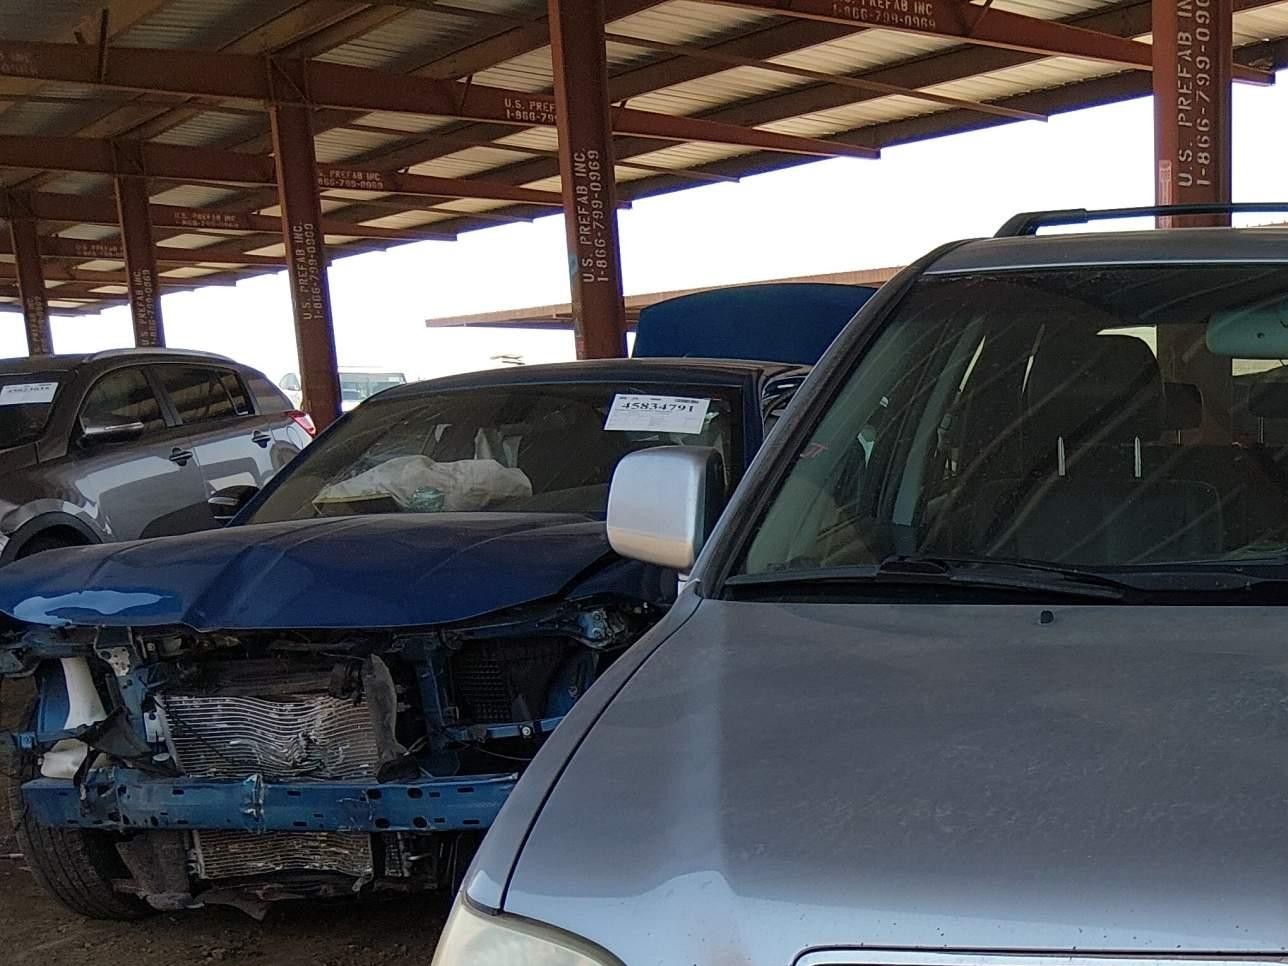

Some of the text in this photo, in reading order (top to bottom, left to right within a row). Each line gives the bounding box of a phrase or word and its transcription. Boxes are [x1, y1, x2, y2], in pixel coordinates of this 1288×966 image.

[1177, 31, 1193, 126] PREFAB
[504, 98, 525, 110] U.S.
[1178, 142, 1193, 187] U.S.
[576, 185, 592, 245] PREFAB
[587, 150, 609, 282] 1-866-799-0969
[295, 249, 309, 293] PREFAB
[582, 254, 594, 282] U.S.
[621, 402, 695, 412] 45834791
